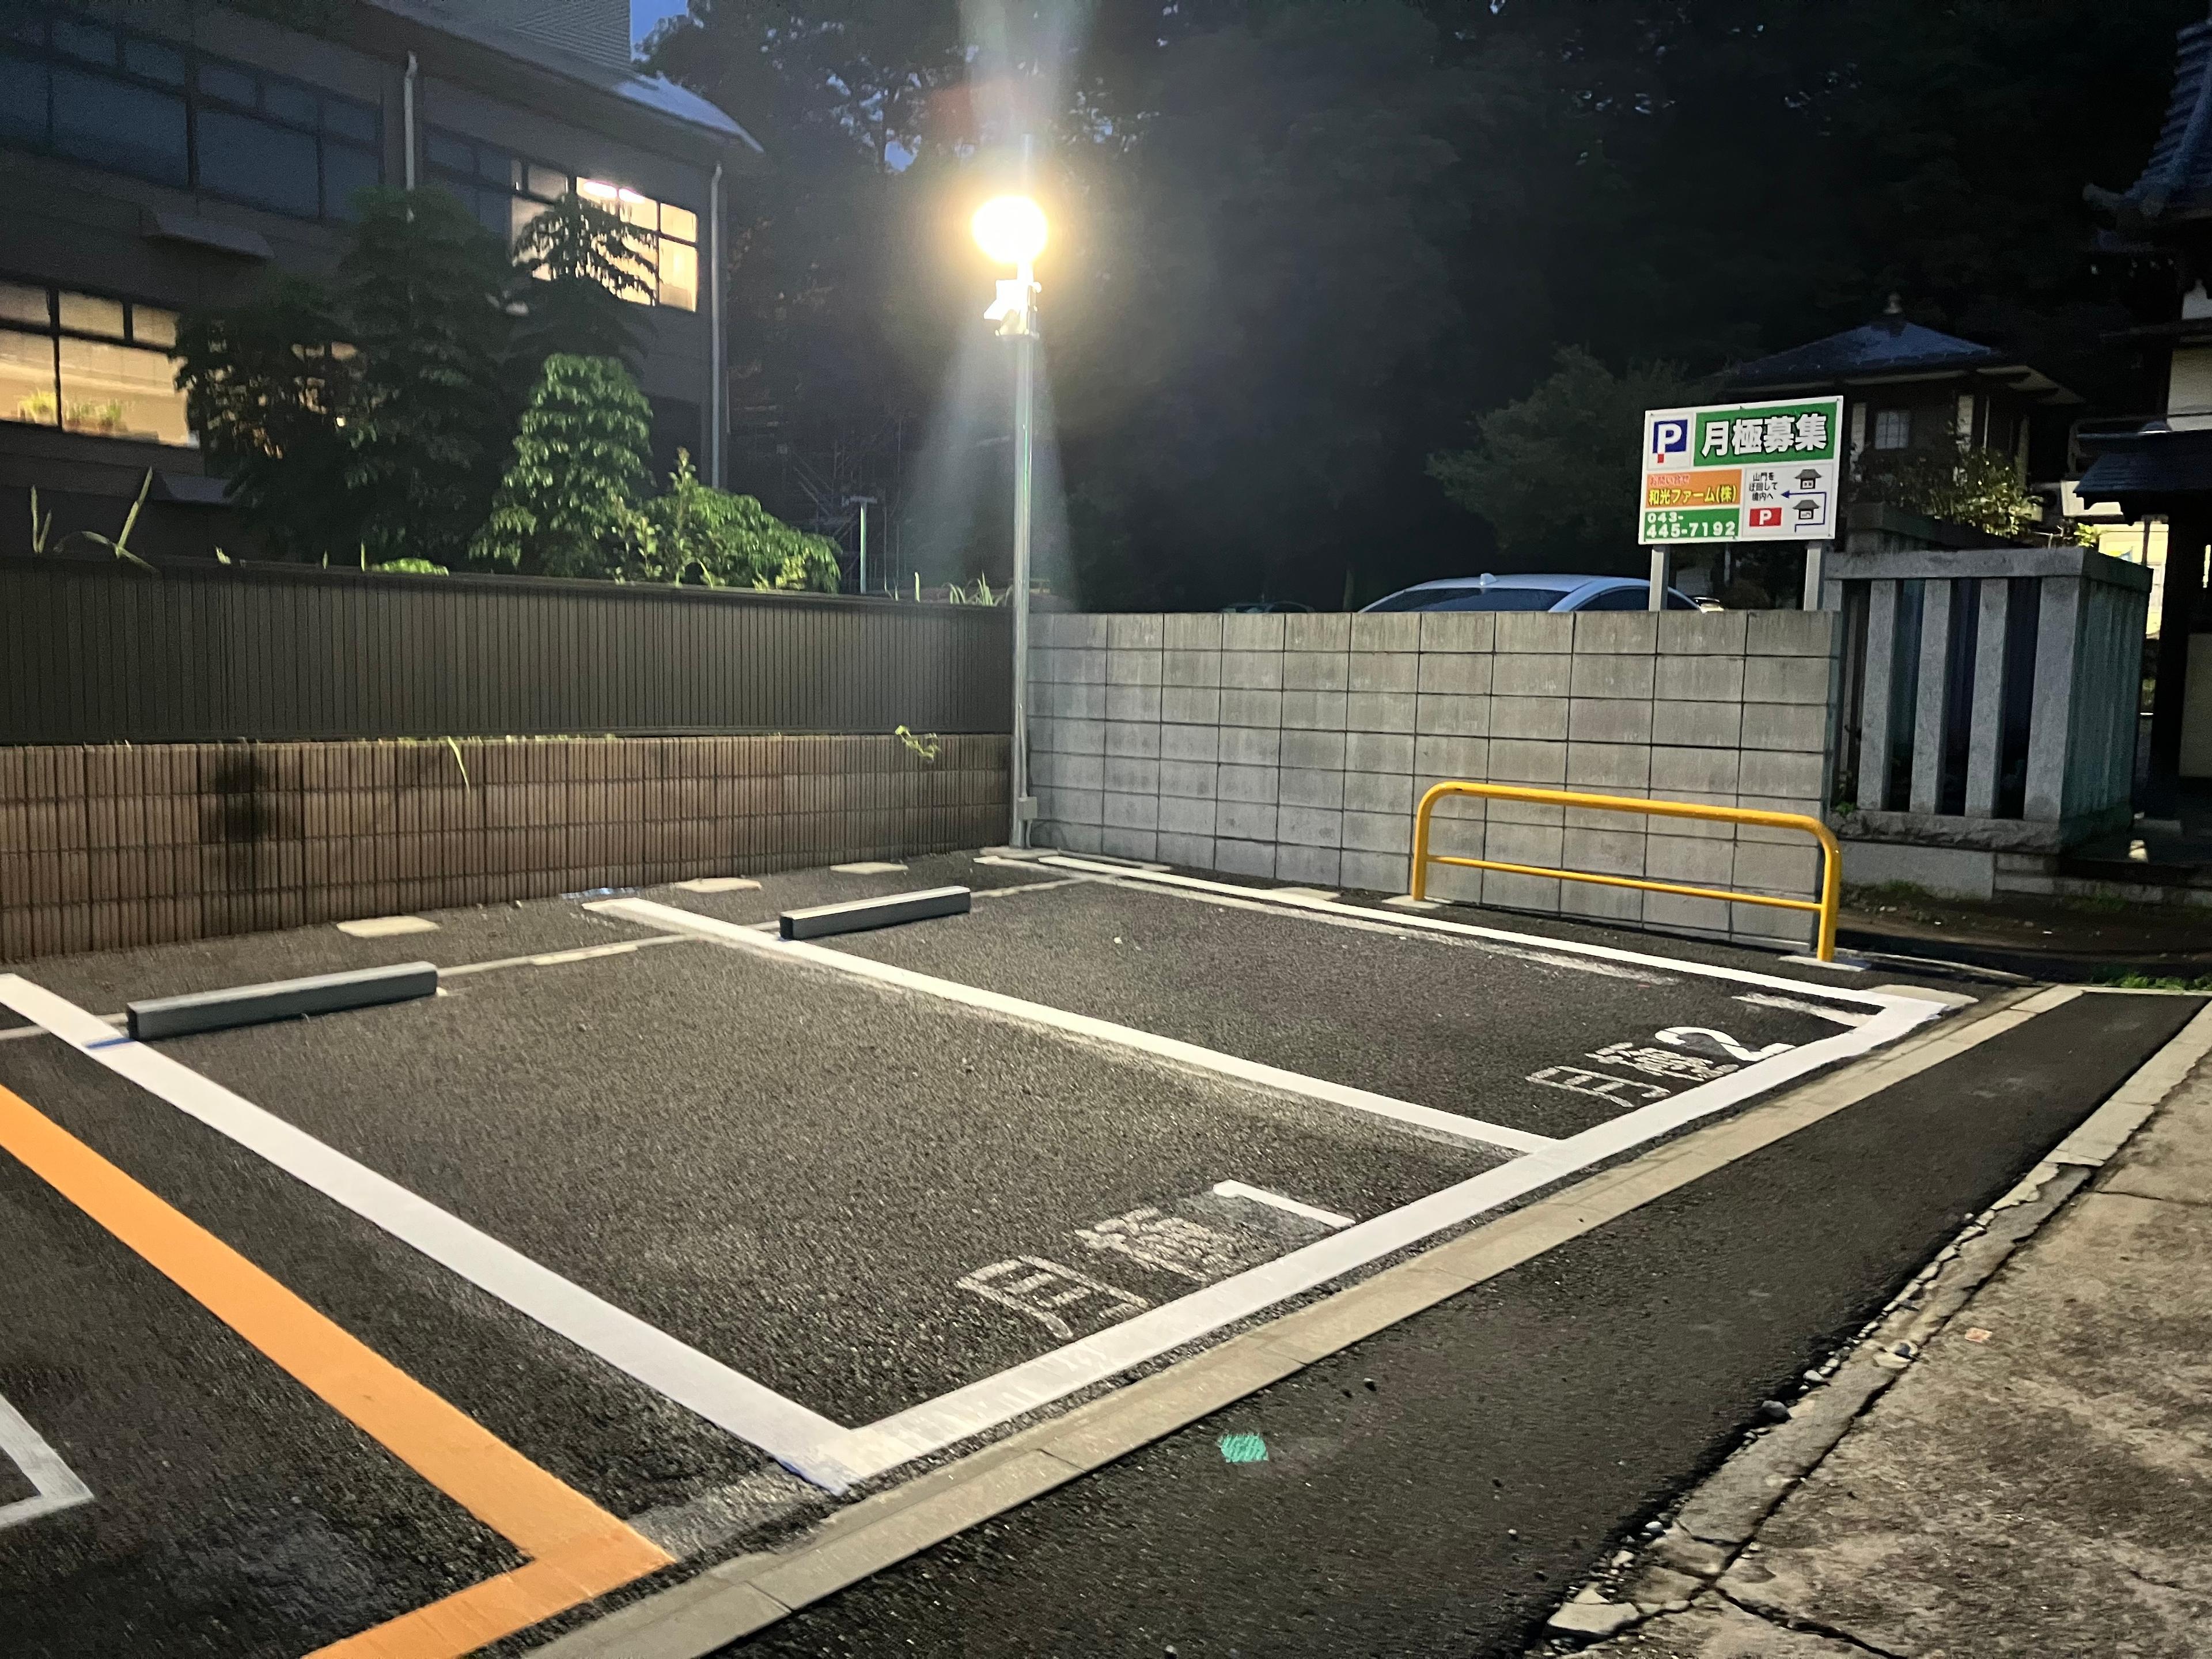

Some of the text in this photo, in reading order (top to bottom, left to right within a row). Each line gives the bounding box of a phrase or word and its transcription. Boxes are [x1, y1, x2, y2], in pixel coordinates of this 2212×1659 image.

[1658, 423, 1682, 455] P
[1701, 413, 1827, 457] 月極募集
[1649, 485, 1737, 506] 和光ファーム(株)
[1647, 511, 1684, 524] 043-
[1759, 509, 1772, 525] P
[1646, 521, 1736, 539] 445-7192
